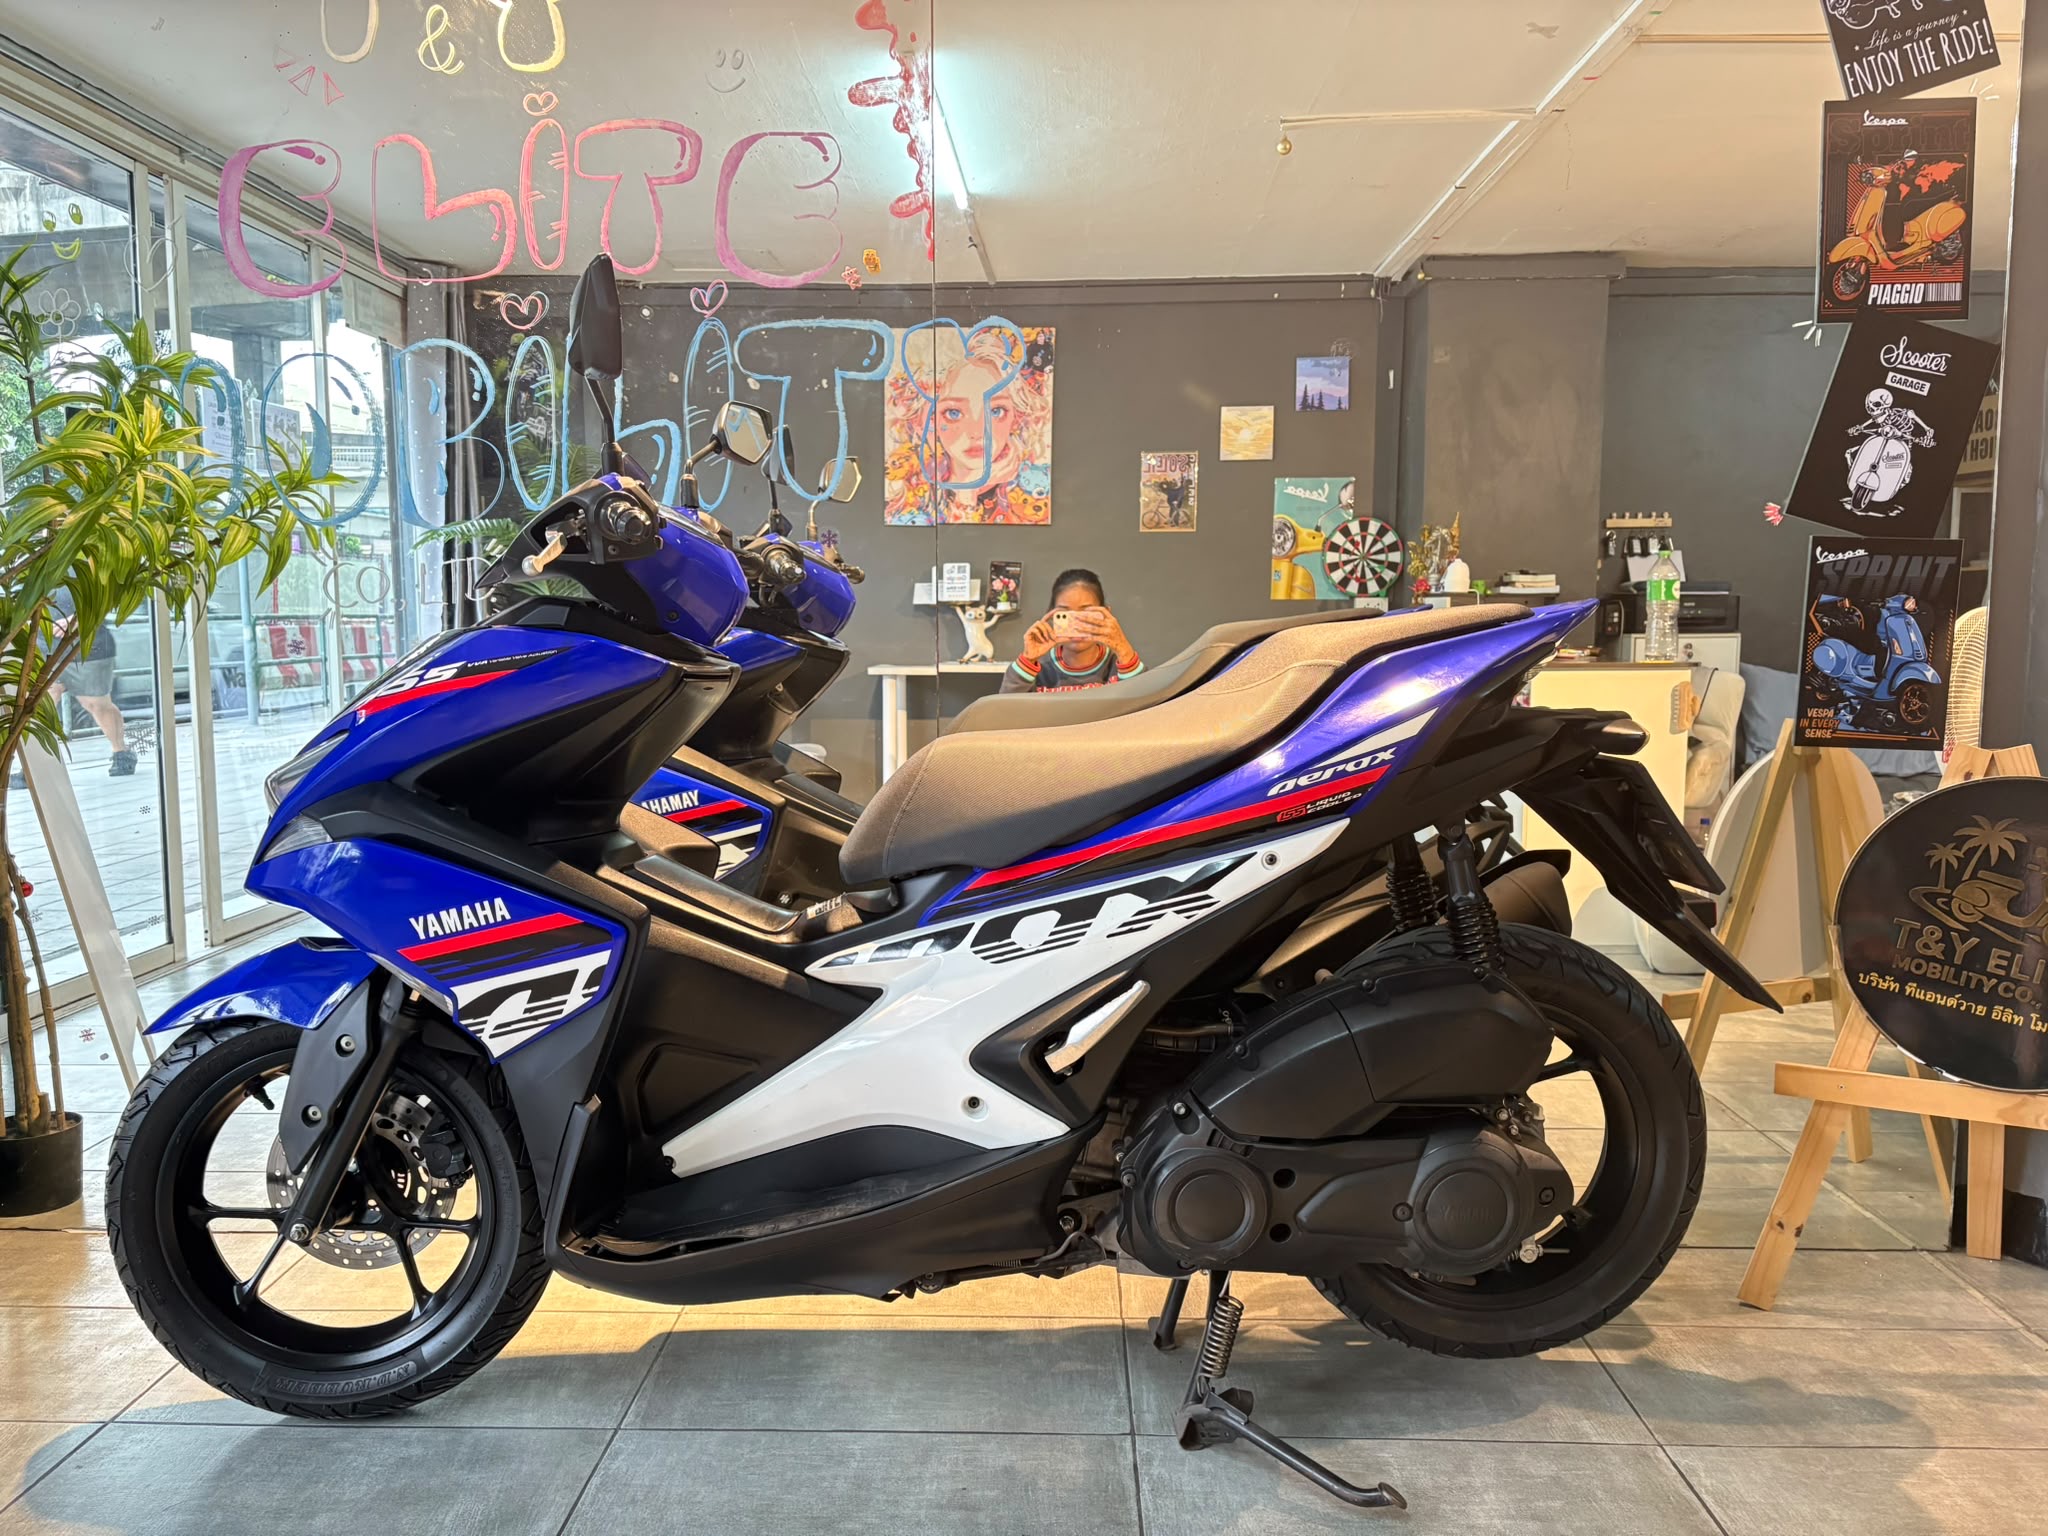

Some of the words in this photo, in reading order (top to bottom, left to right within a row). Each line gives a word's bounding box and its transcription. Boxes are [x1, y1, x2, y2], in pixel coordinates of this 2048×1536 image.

[1864, 29, 1891, 51] Life
[1892, 30, 1902, 41] is
[1906, 29, 1913, 37] a
[1914, 13, 1960, 39] journey
[1844, 49, 1905, 98] ENJOY
[1903, 37, 1941, 78] THE
[1940, 18, 1994, 68] RIDE!
[1863, 109, 1909, 127] Vespa
[1867, 282, 1926, 306] PIAGGIO
[1879, 335, 1952, 375] Scooter
[1889, 374, 1928, 393] GARAGE
[1815, 545, 1869, 565] Vespa
[1818, 554, 1957, 594] SPRINT
[1800, 718, 1810, 728] IN
[1812, 718, 1840, 729] EVERY
[1807, 708, 1835, 718] VESPA
[1805, 728, 1833, 739] SENSE
[1266, 746, 1398, 797] aerox
[1306, 791, 1352, 809] LIQUID
[1307, 792, 1362, 814] COOLED
[408, 896, 512, 941] YAMAHA
[1893, 917, 1981, 965] T&Y
[1858, 972, 1900, 993] บริษัท
